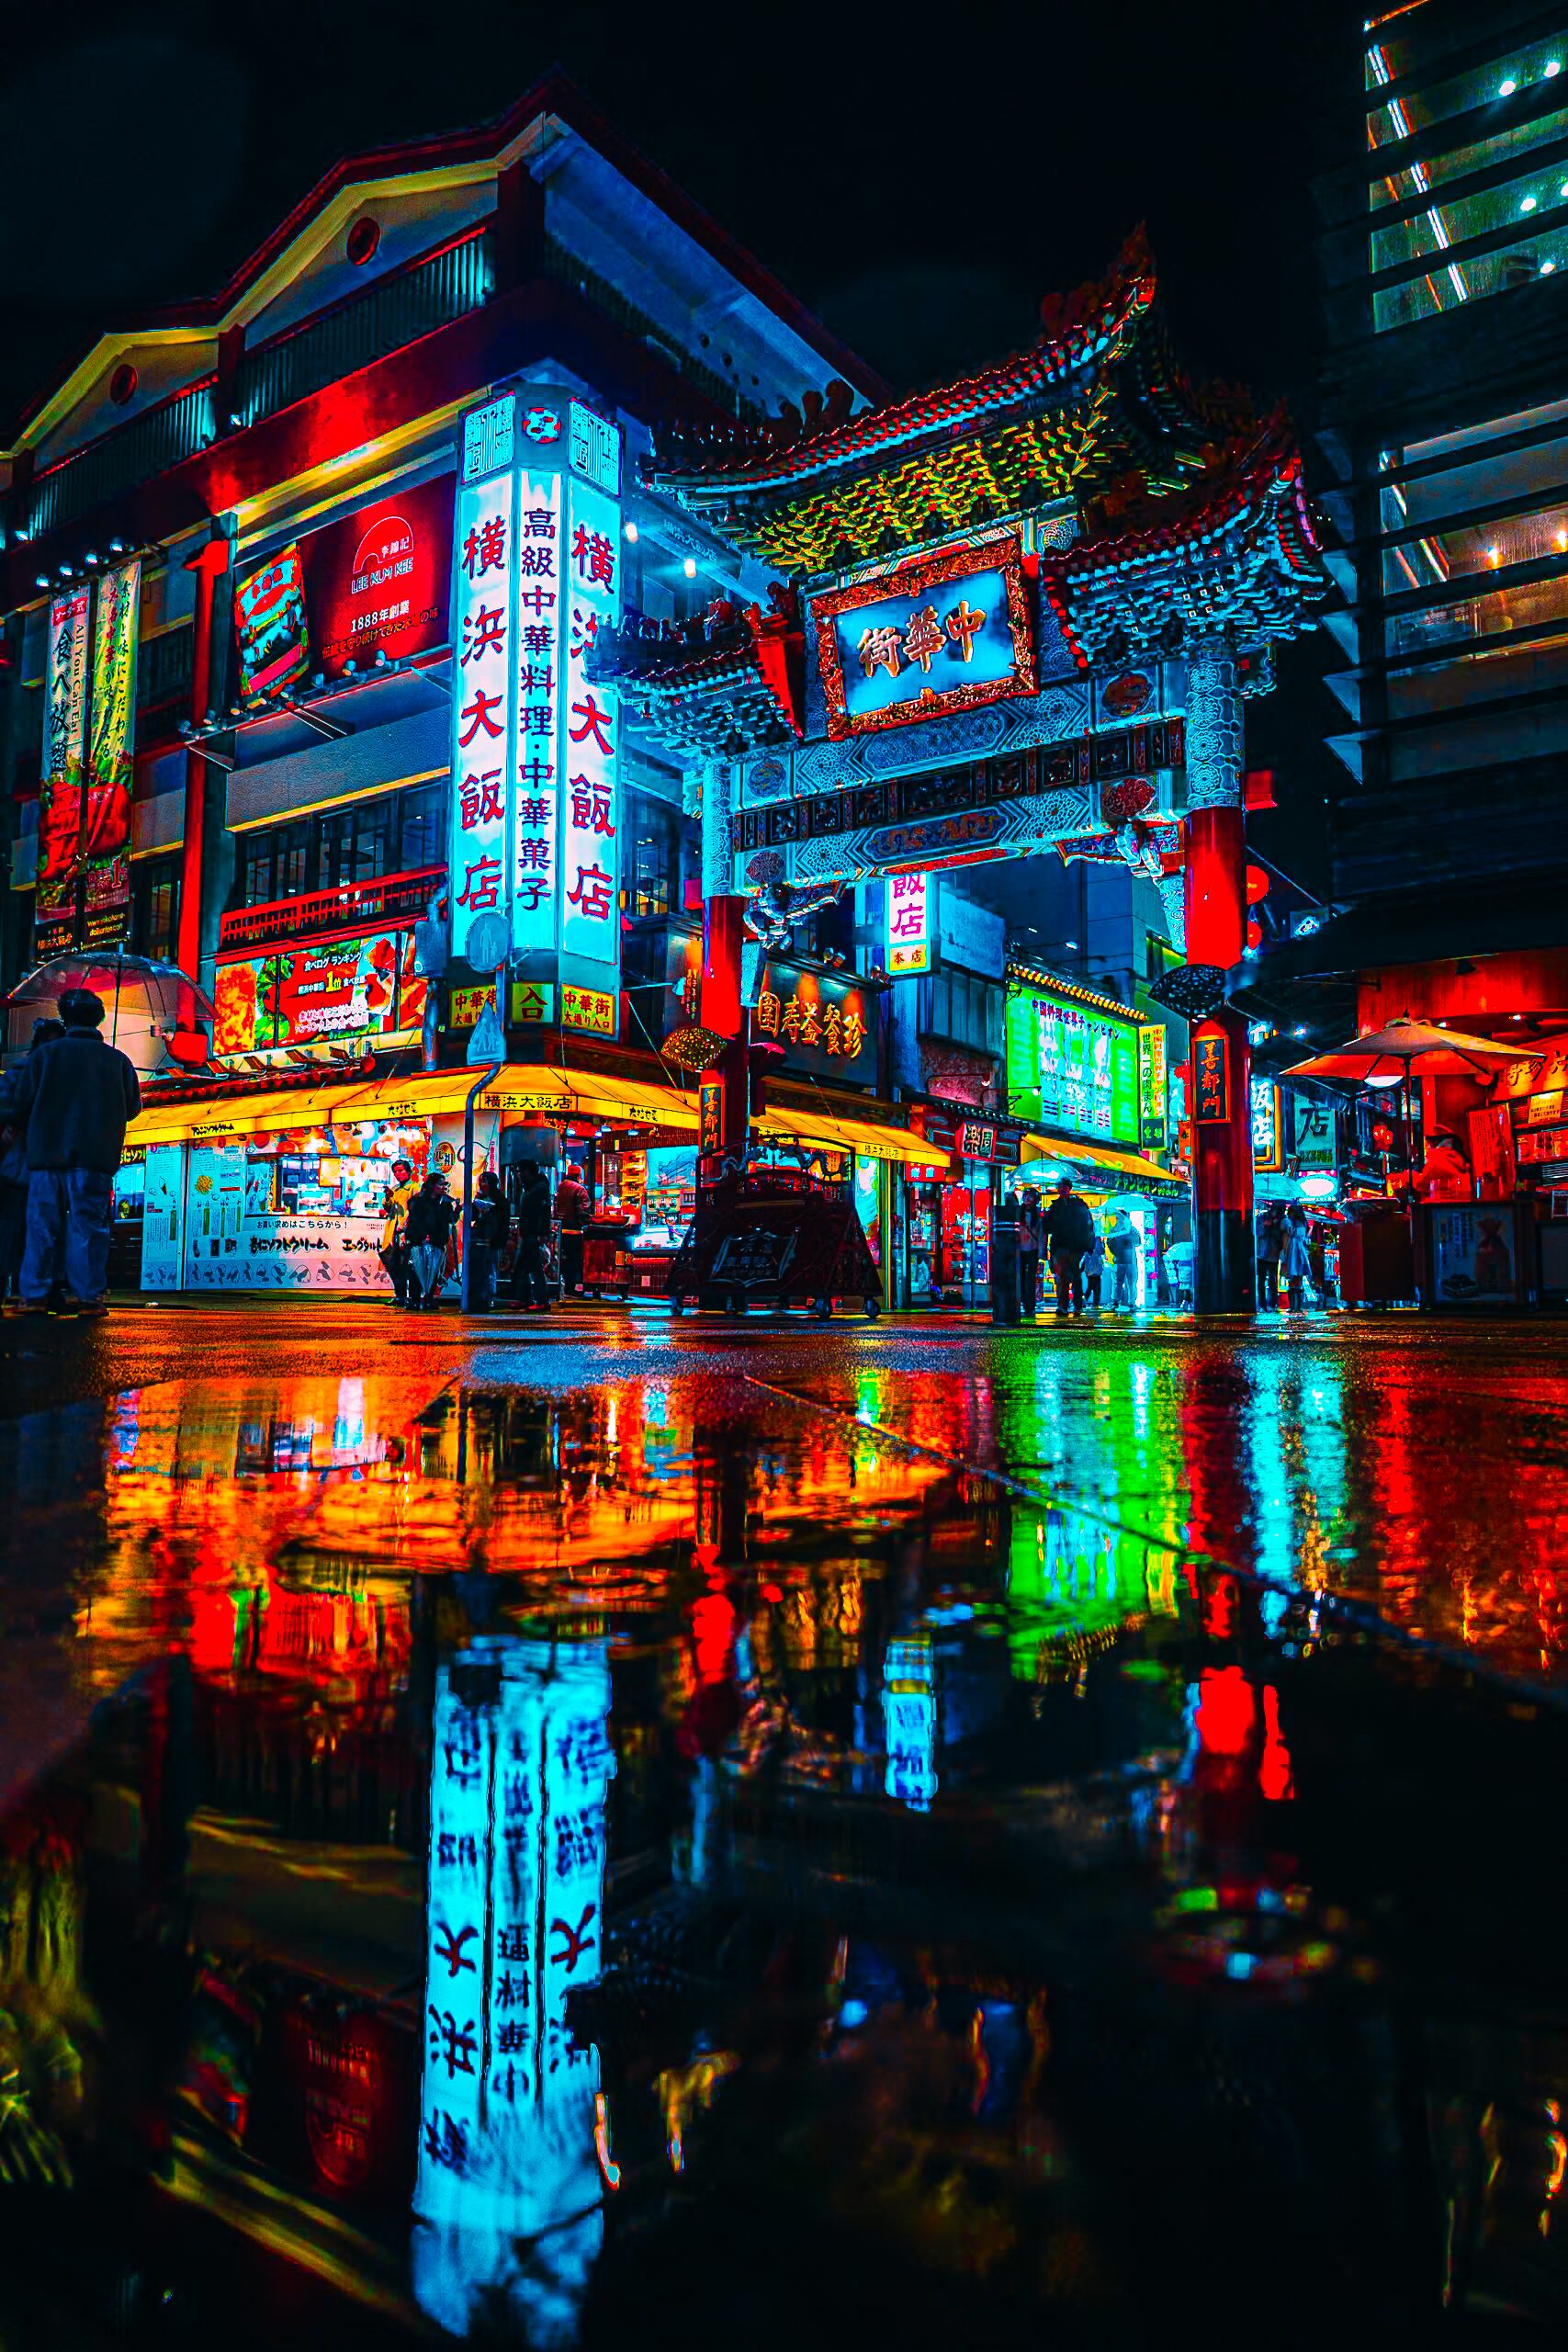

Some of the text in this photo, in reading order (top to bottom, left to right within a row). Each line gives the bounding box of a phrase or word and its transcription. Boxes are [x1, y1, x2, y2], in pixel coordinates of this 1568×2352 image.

[352, 557, 413, 594] LEE KUM KEE
[350, 600, 410, 632] 1888年創業
[74, 623, 85, 645] All
[856, 600, 987, 678] 中華街
[456, 514, 507, 912] 横浜大飯店
[516, 507, 557, 910] 高級中華料理・中華菓子
[304, 950, 363, 972] 食べログ ランキング
[894, 949, 922, 966] 本店
[520, 987, 548, 1021] 入口
[563, 990, 610, 1017] 中華街
[564, 1012, 610, 1029] 大通り入口
[485, 1095, 573, 1110] 横浜大飯店
